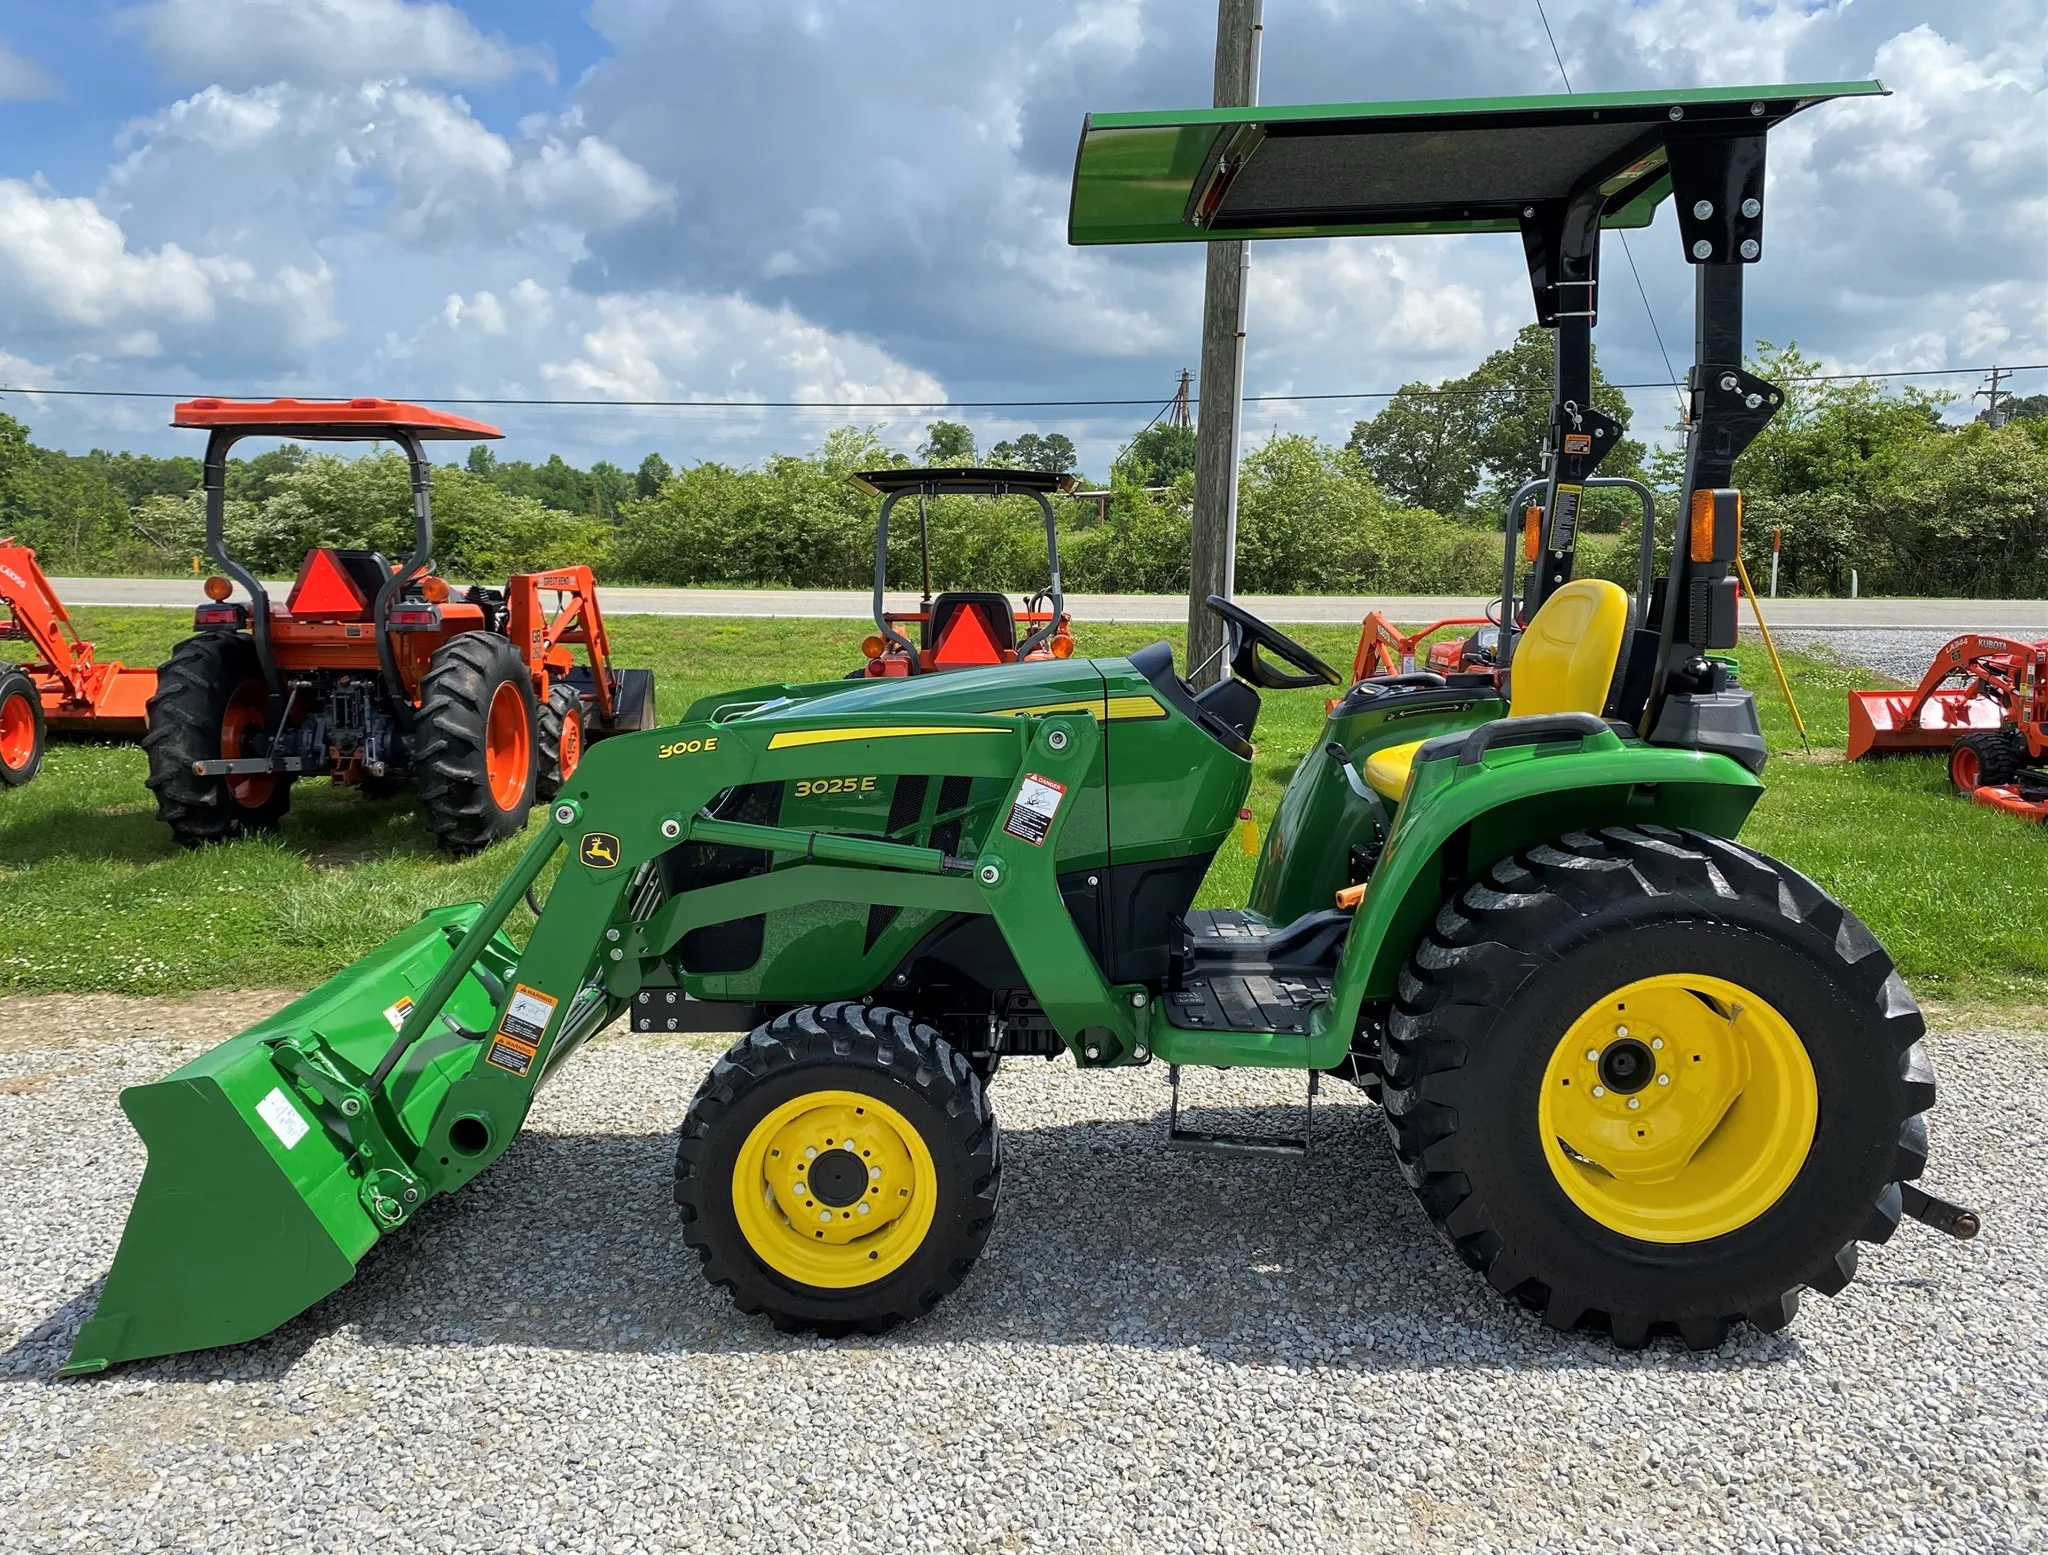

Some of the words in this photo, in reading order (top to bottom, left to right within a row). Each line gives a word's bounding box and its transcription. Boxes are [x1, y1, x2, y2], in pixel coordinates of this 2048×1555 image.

[1978, 638, 2007, 652] KUBOTA
[1038, 776, 1062, 790] DANGER
[526, 987, 553, 1004] WARNING
[506, 1039, 531, 1055] WARNING
